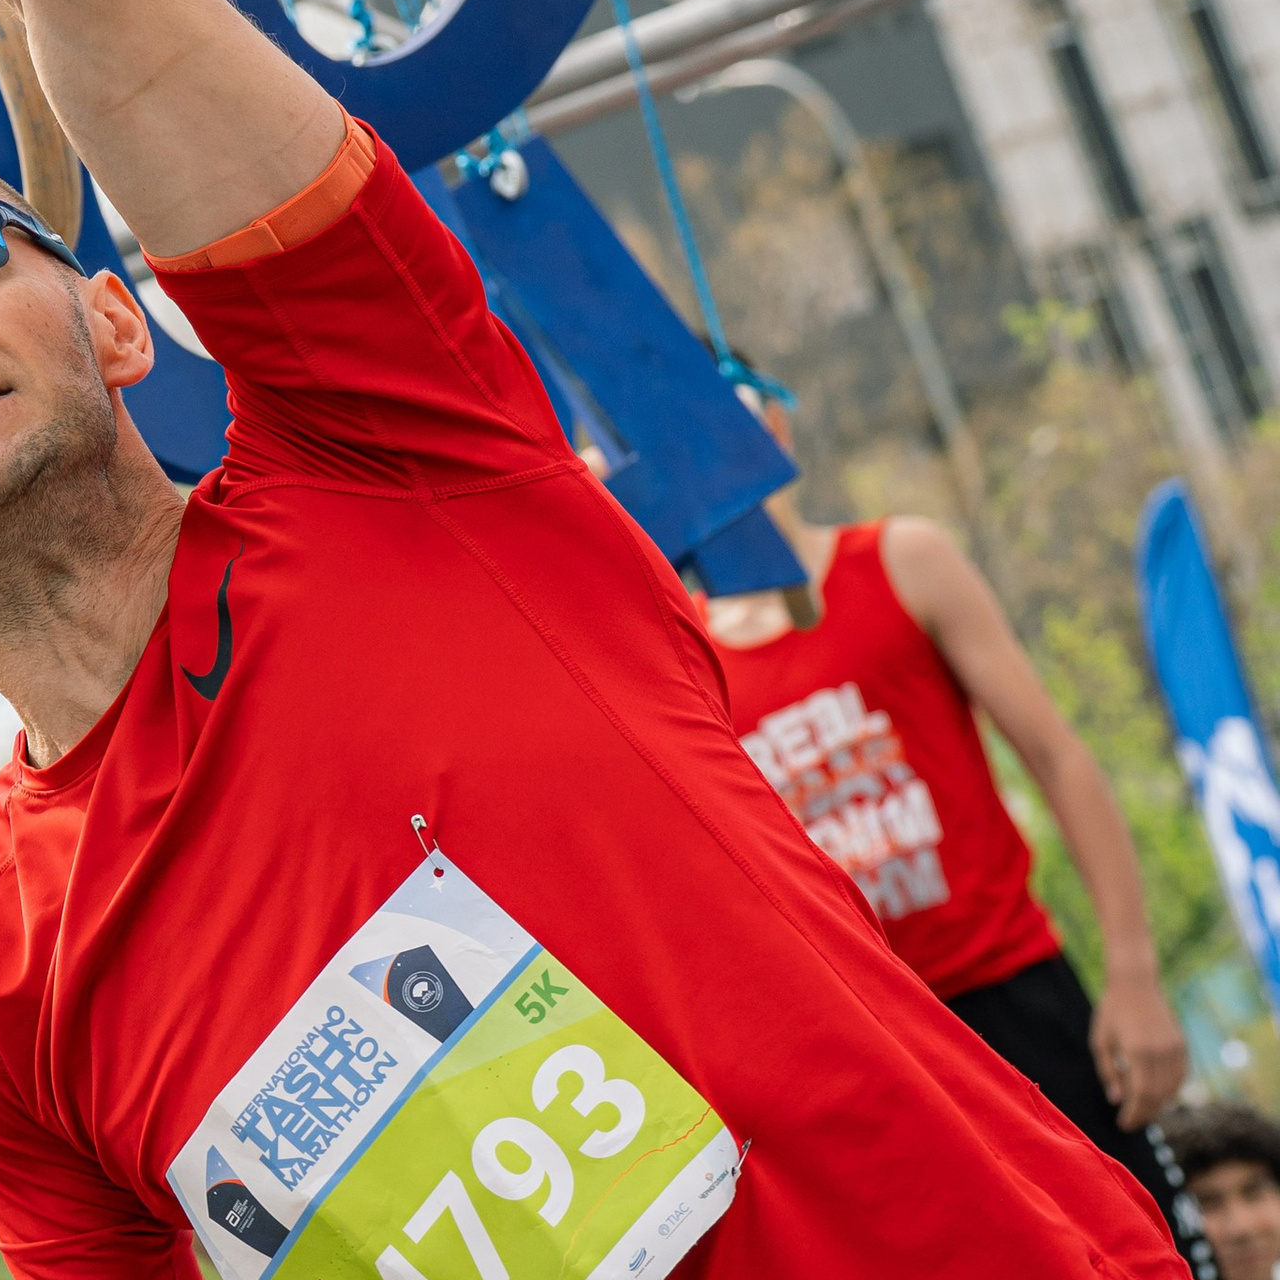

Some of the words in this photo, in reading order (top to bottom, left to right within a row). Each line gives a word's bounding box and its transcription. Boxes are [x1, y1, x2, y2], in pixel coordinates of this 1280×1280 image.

[513, 969, 571, 1025] 5K
[323, 1004, 399, 1078] 2026
[229, 1023, 325, 1136] INTERNATIONAL
[281, 1068, 387, 1192] MARATHON
[665, 1200, 690, 1226] TIAC
